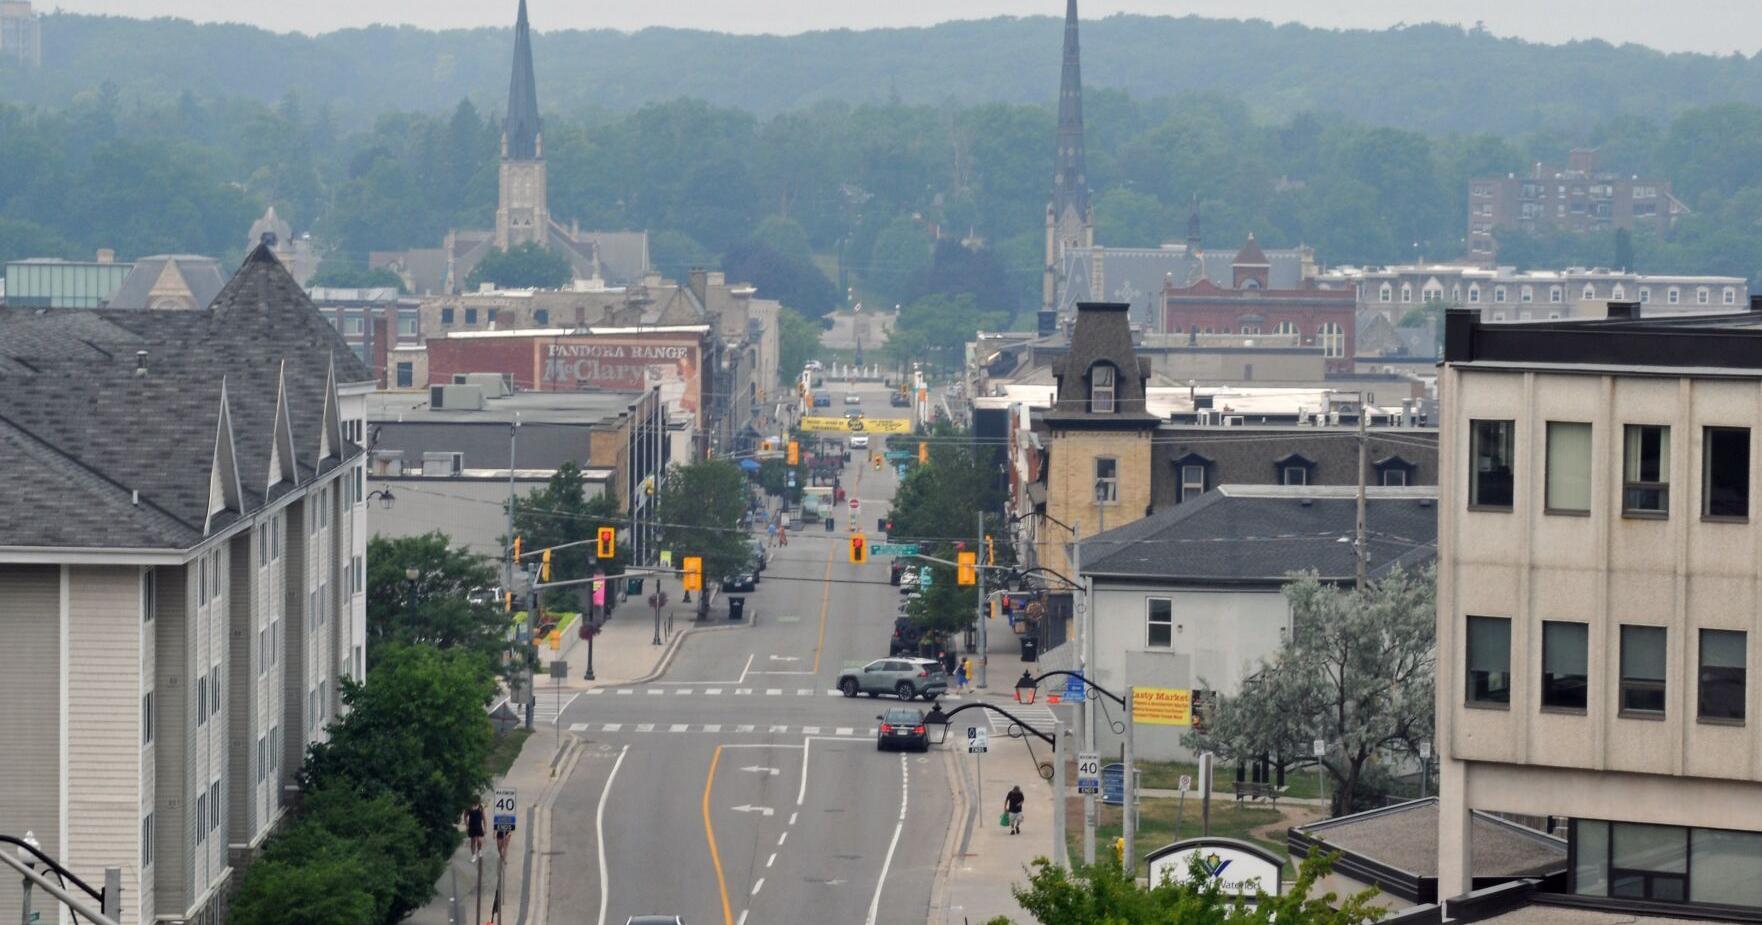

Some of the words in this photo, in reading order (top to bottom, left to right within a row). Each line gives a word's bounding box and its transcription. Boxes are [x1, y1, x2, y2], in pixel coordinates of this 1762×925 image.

[548, 344, 624, 357] PANDORA
[631, 346, 687, 358] RANGE
[1156, 693, 1188, 702] Market
[1080, 762, 1097, 774] 40
[496, 798, 515, 811] 40
